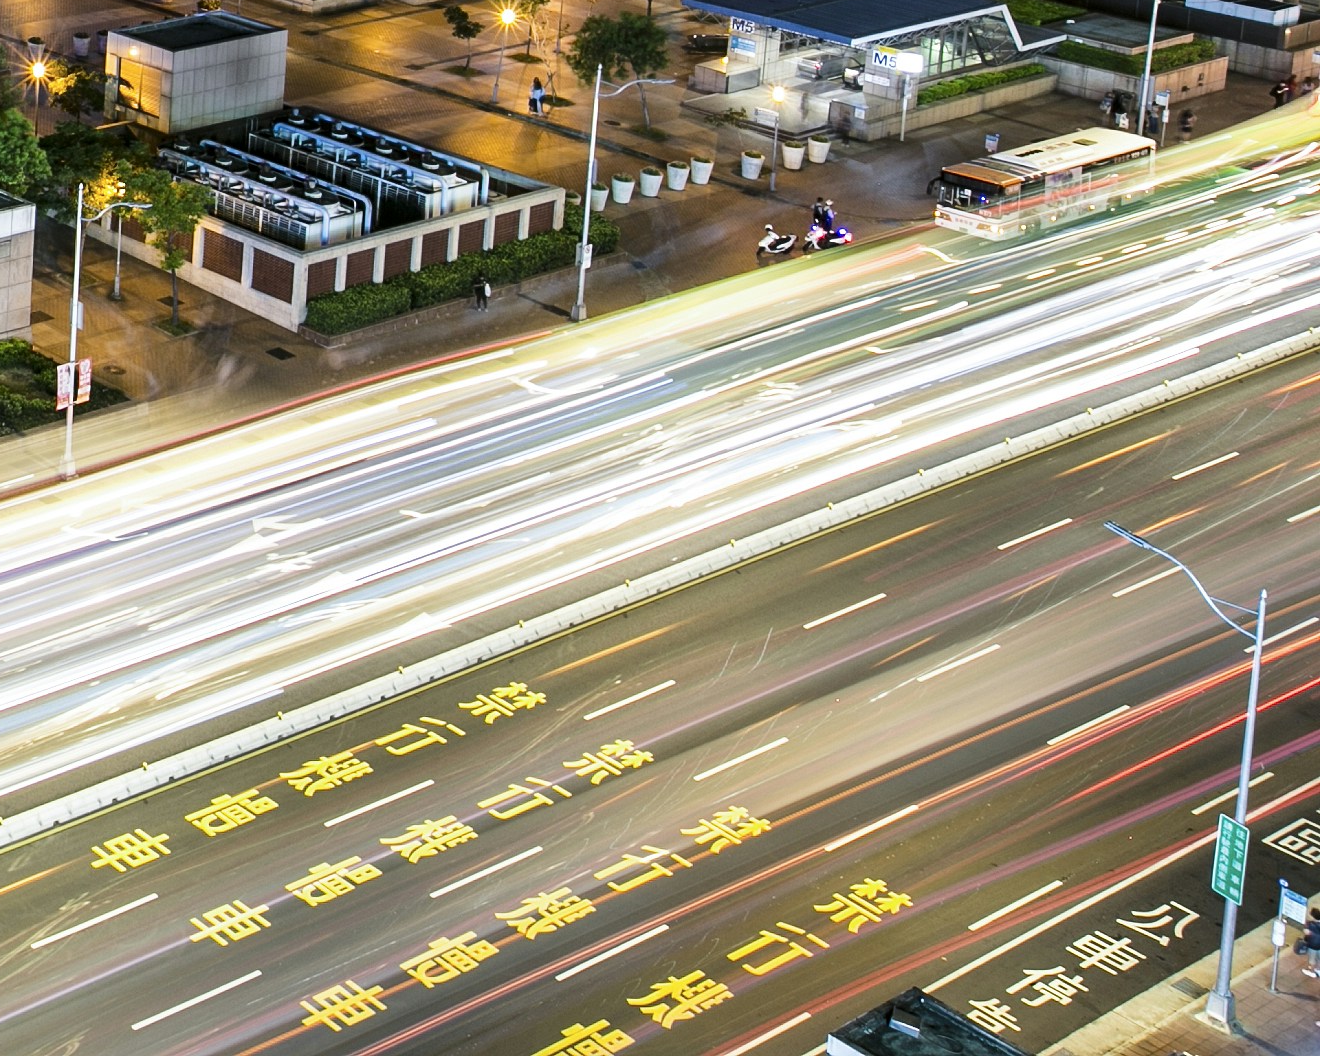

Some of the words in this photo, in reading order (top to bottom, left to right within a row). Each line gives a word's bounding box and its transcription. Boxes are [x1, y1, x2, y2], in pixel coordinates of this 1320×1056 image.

[732, 18, 754, 33] M5
[873, 52, 897, 68] M5
[90, 681, 548, 873] 禁行機慢車
[189, 739, 655, 947] 禁行機慢車
[300, 805, 772, 1033] 禁行機慢車
